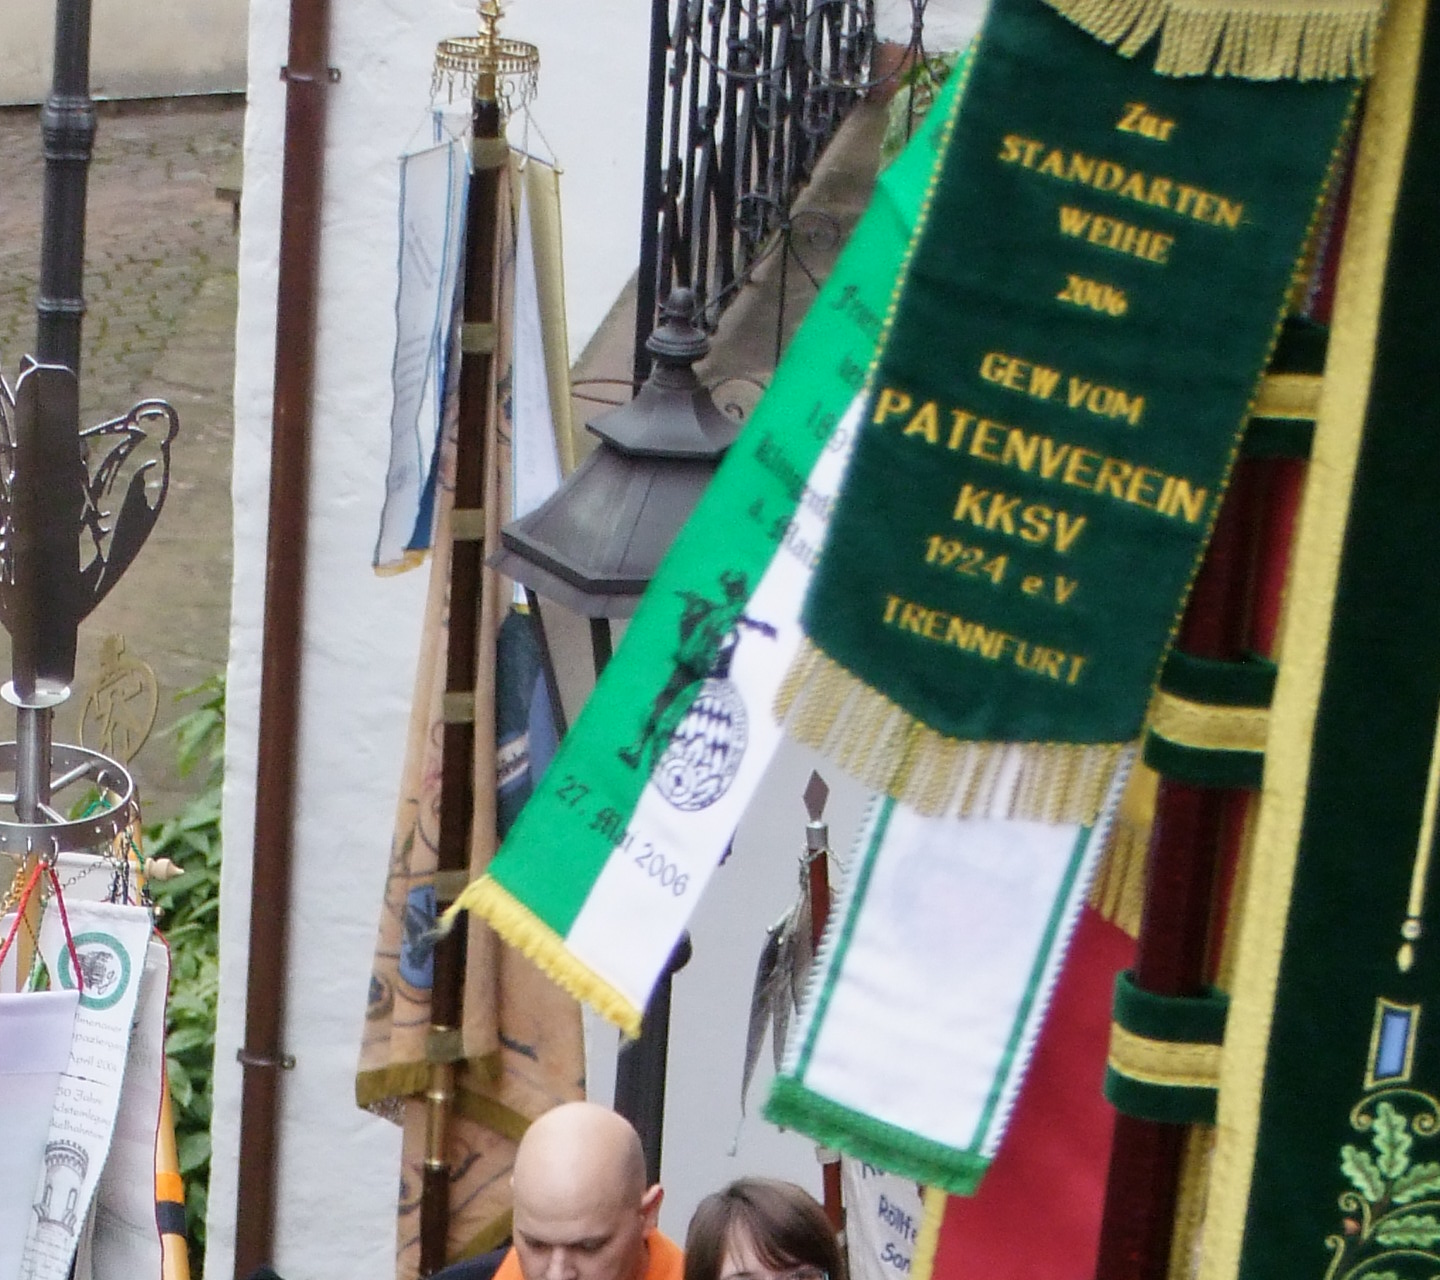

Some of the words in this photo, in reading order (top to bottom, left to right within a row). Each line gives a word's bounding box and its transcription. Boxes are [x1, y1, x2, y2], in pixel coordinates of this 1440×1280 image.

[1116, 101, 1177, 142] Zur
[998, 134, 1244, 230] STANDARTEN
[1058, 204, 1176, 264] WEIHE
[1056, 273, 1129, 317] 2006
[980, 352, 1059, 399] GEW
[1067, 376, 1145, 426] VOM
[872, 387, 1207, 523] PATENVEREIN
[952, 483, 1087, 552] KKSV
[924, 535, 1007, 584] 1924
[881, 594, 1087, 685] TRENNFURT
[635, 843, 689, 897] 2006
